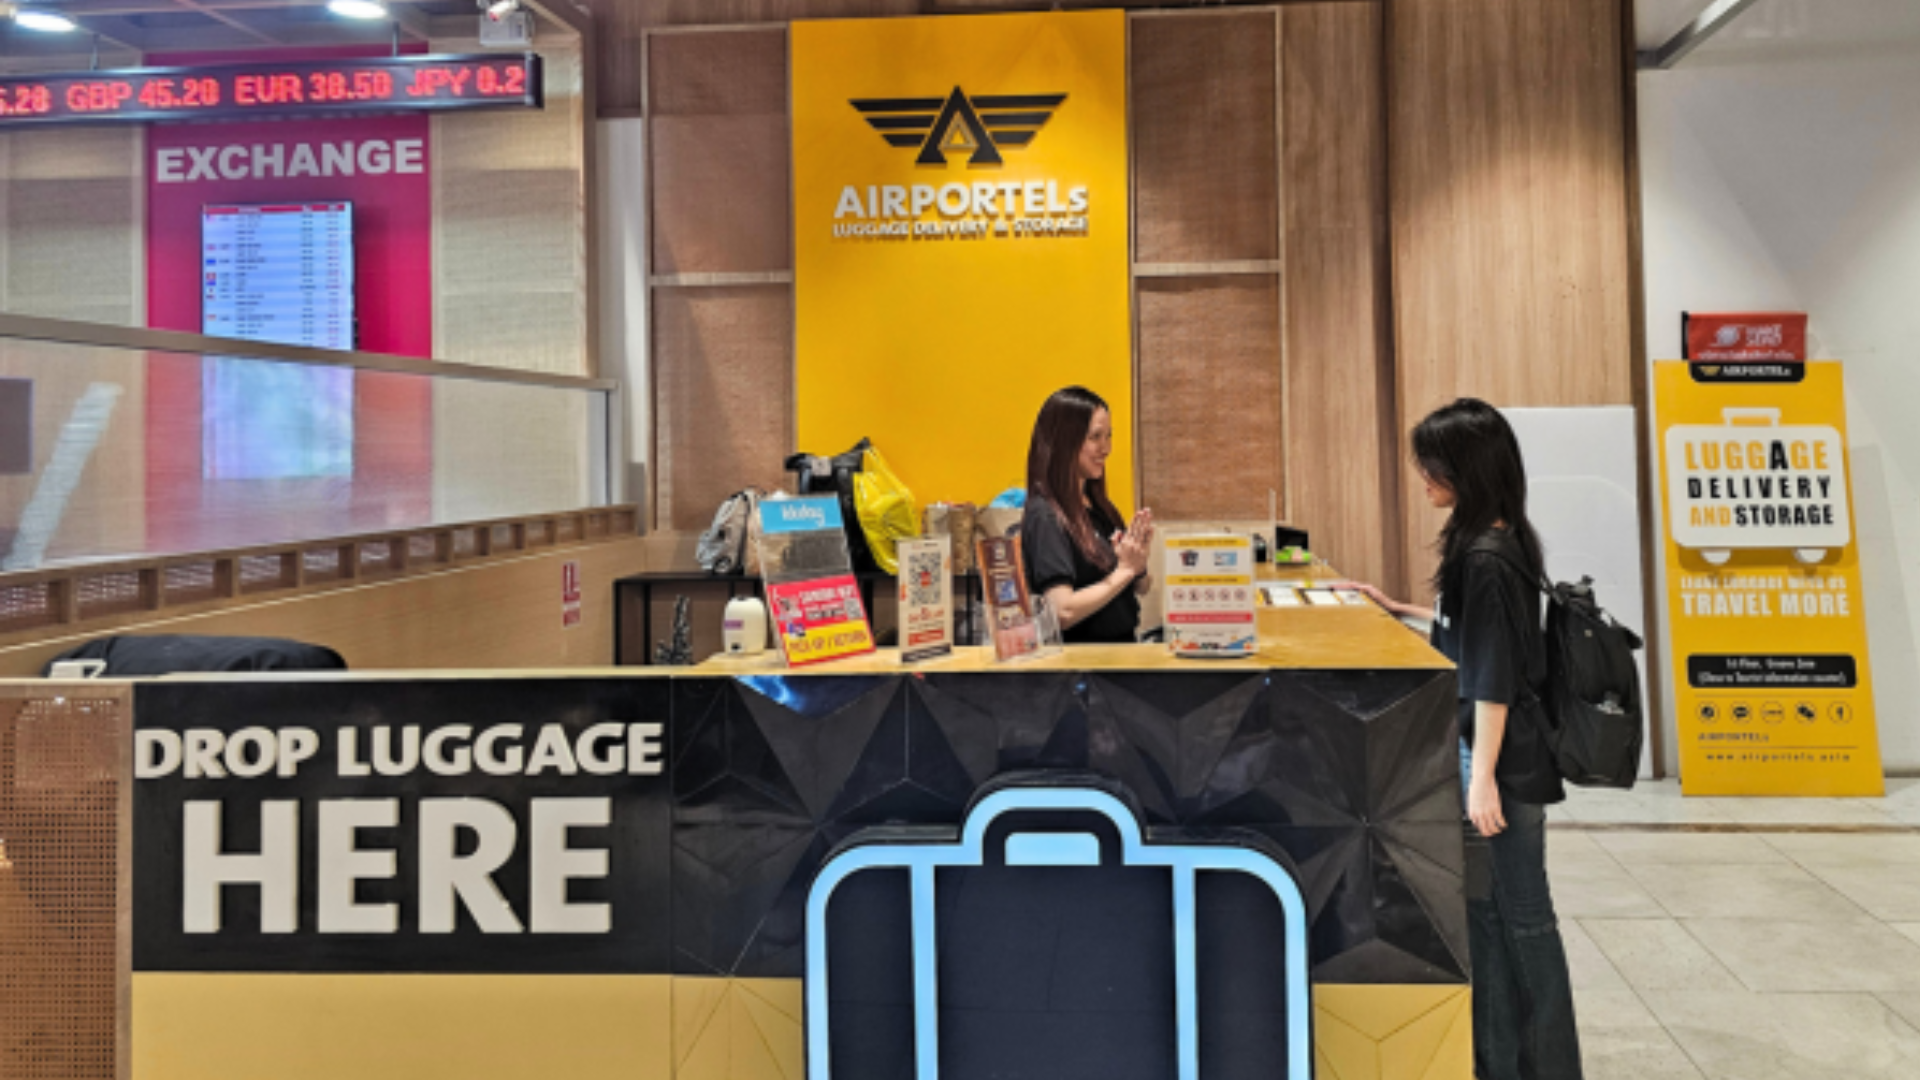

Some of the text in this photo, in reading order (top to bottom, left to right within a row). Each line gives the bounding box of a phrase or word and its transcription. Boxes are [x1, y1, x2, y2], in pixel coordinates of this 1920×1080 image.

[66, 82, 132, 112] GBP
[138, 78, 220, 107] 45.20
[234, 75, 303, 105] EUR
[406, 67, 471, 97] JPY
[156, 139, 423, 182] EXCHANGE
[834, 180, 1089, 219] AIRPORTELs
[833, 221, 909, 237] LUGGAGE
[913, 220, 989, 237] DELIVERY
[1015, 216, 1088, 234] STORAGE
[1684, 439, 1828, 470] LUGGAGE
[1687, 476, 1831, 499] DELIVERY
[1690, 504, 1834, 527] AND STORAGE
[1681, 592, 1850, 617] TRAVEL MORE
[134, 723, 664, 779] DROP LUGGAGE
[182, 797, 611, 934] HERE
